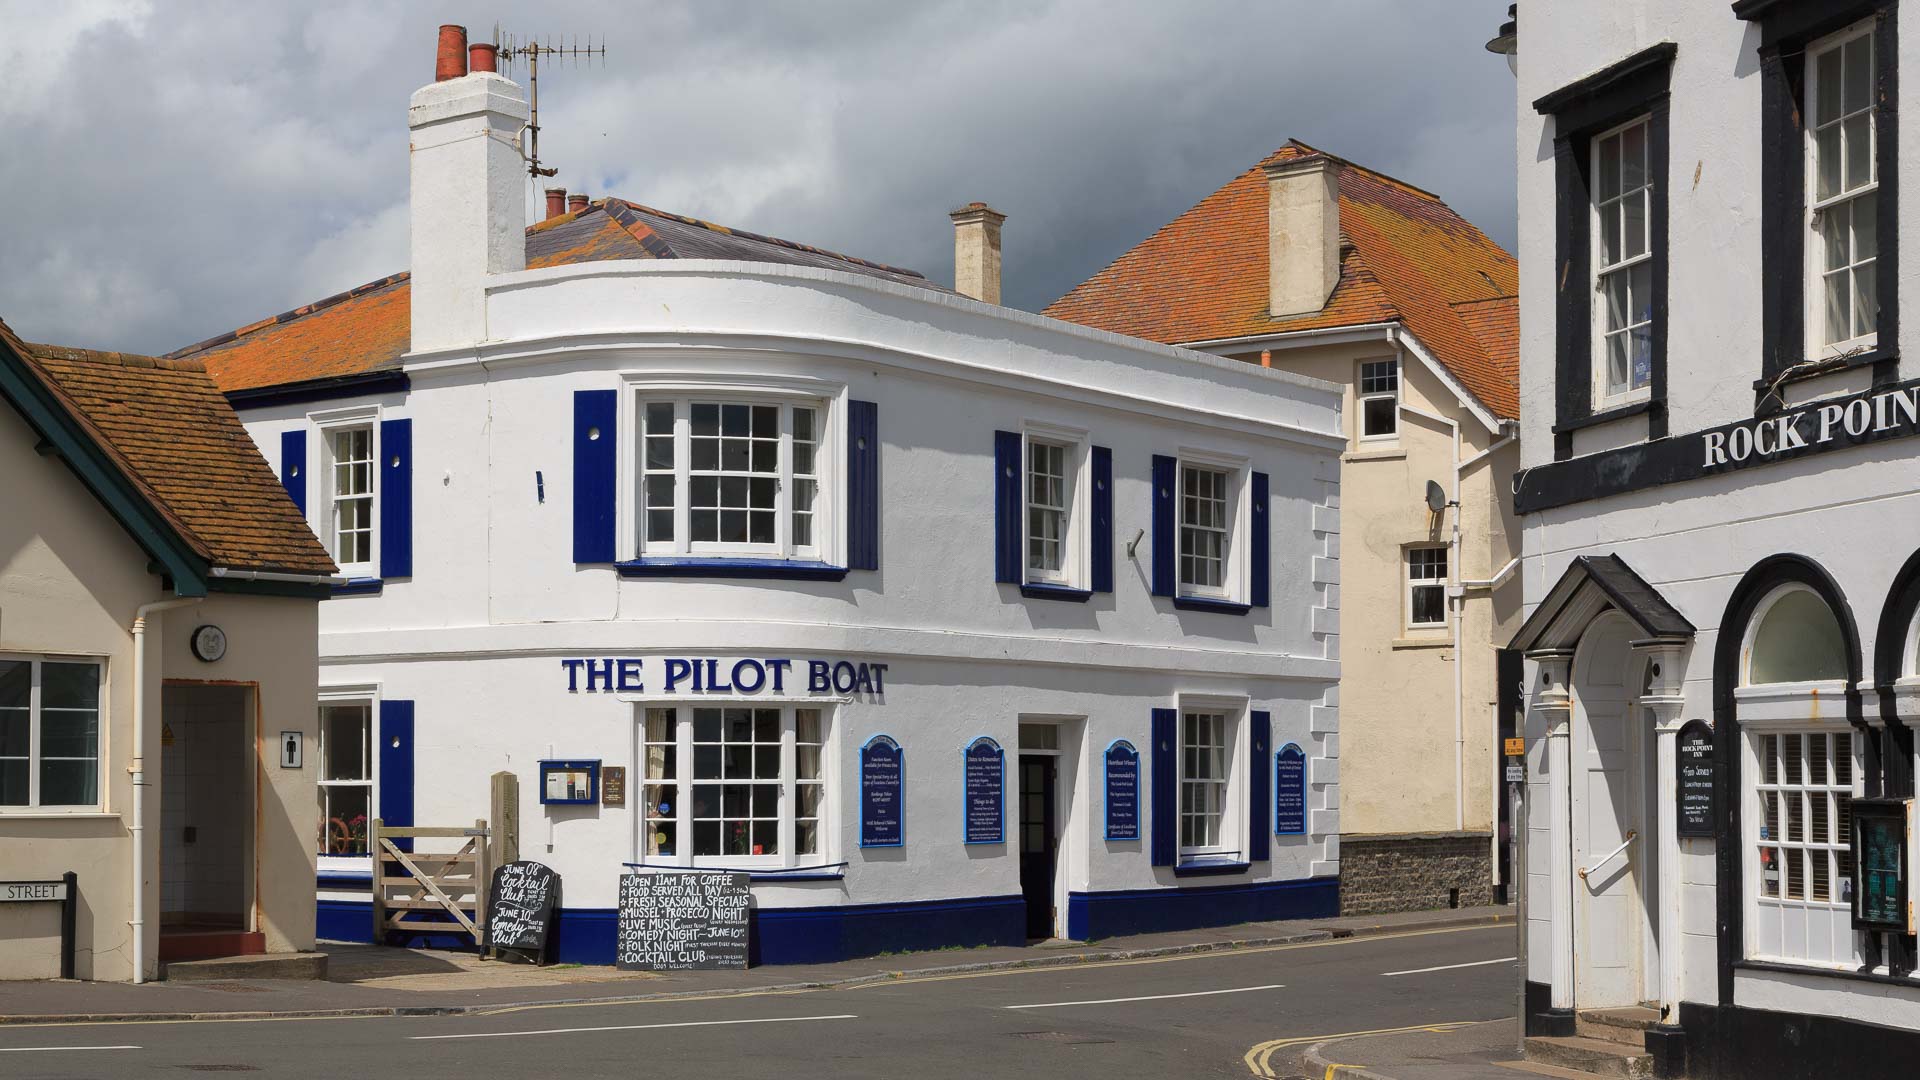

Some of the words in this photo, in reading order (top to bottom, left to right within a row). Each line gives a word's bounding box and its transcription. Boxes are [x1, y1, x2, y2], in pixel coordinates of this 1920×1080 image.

[1701, 411, 1809, 468] ROCK
[561, 658, 644, 692] THE
[663, 658, 791, 692] PILOT
[807, 660, 889, 694] BOAT
[504, 864, 525, 874] JUNE
[500, 874, 550, 891] Cocktail
[628, 875, 650, 886] OPEN
[656, 874, 676, 886] 11AM
[681, 875, 697, 886] FOR
[700, 875, 733, 886] COFFEE
[8, 885, 59, 899] STREET
[500, 886, 526, 902] Club
[629, 887, 650, 897] FOOD
[651, 886, 683, 896] SERVED
[685, 886, 702, 896] ALL
[705, 885, 722, 897] DAY
[628, 896, 656, 908] FRESH
[658, 896, 705, 908] SEASONAL
[706, 895, 749, 907] SPECIALS
[498, 908, 519, 918] JUNE
[625, 907, 660, 918] MUSSEL
[666, 907, 710, 919] PROSECCO
[712, 907, 745, 920] NIGHT
[491, 916, 528, 938] Comedy
[626, 920, 645, 930] LIVE
[649, 918, 680, 930] MUSIC
[492, 930, 517, 945] Club
[626, 929, 665, 941] COMEDY
[667, 929, 700, 940] NIGHT
[707, 927, 730, 937] JUNE
[627, 941, 651, 952] FOLK
[654, 940, 686, 952] NIGHT
[625, 952, 676, 963] COCKTAIL
[678, 950, 705, 962] CLUB
